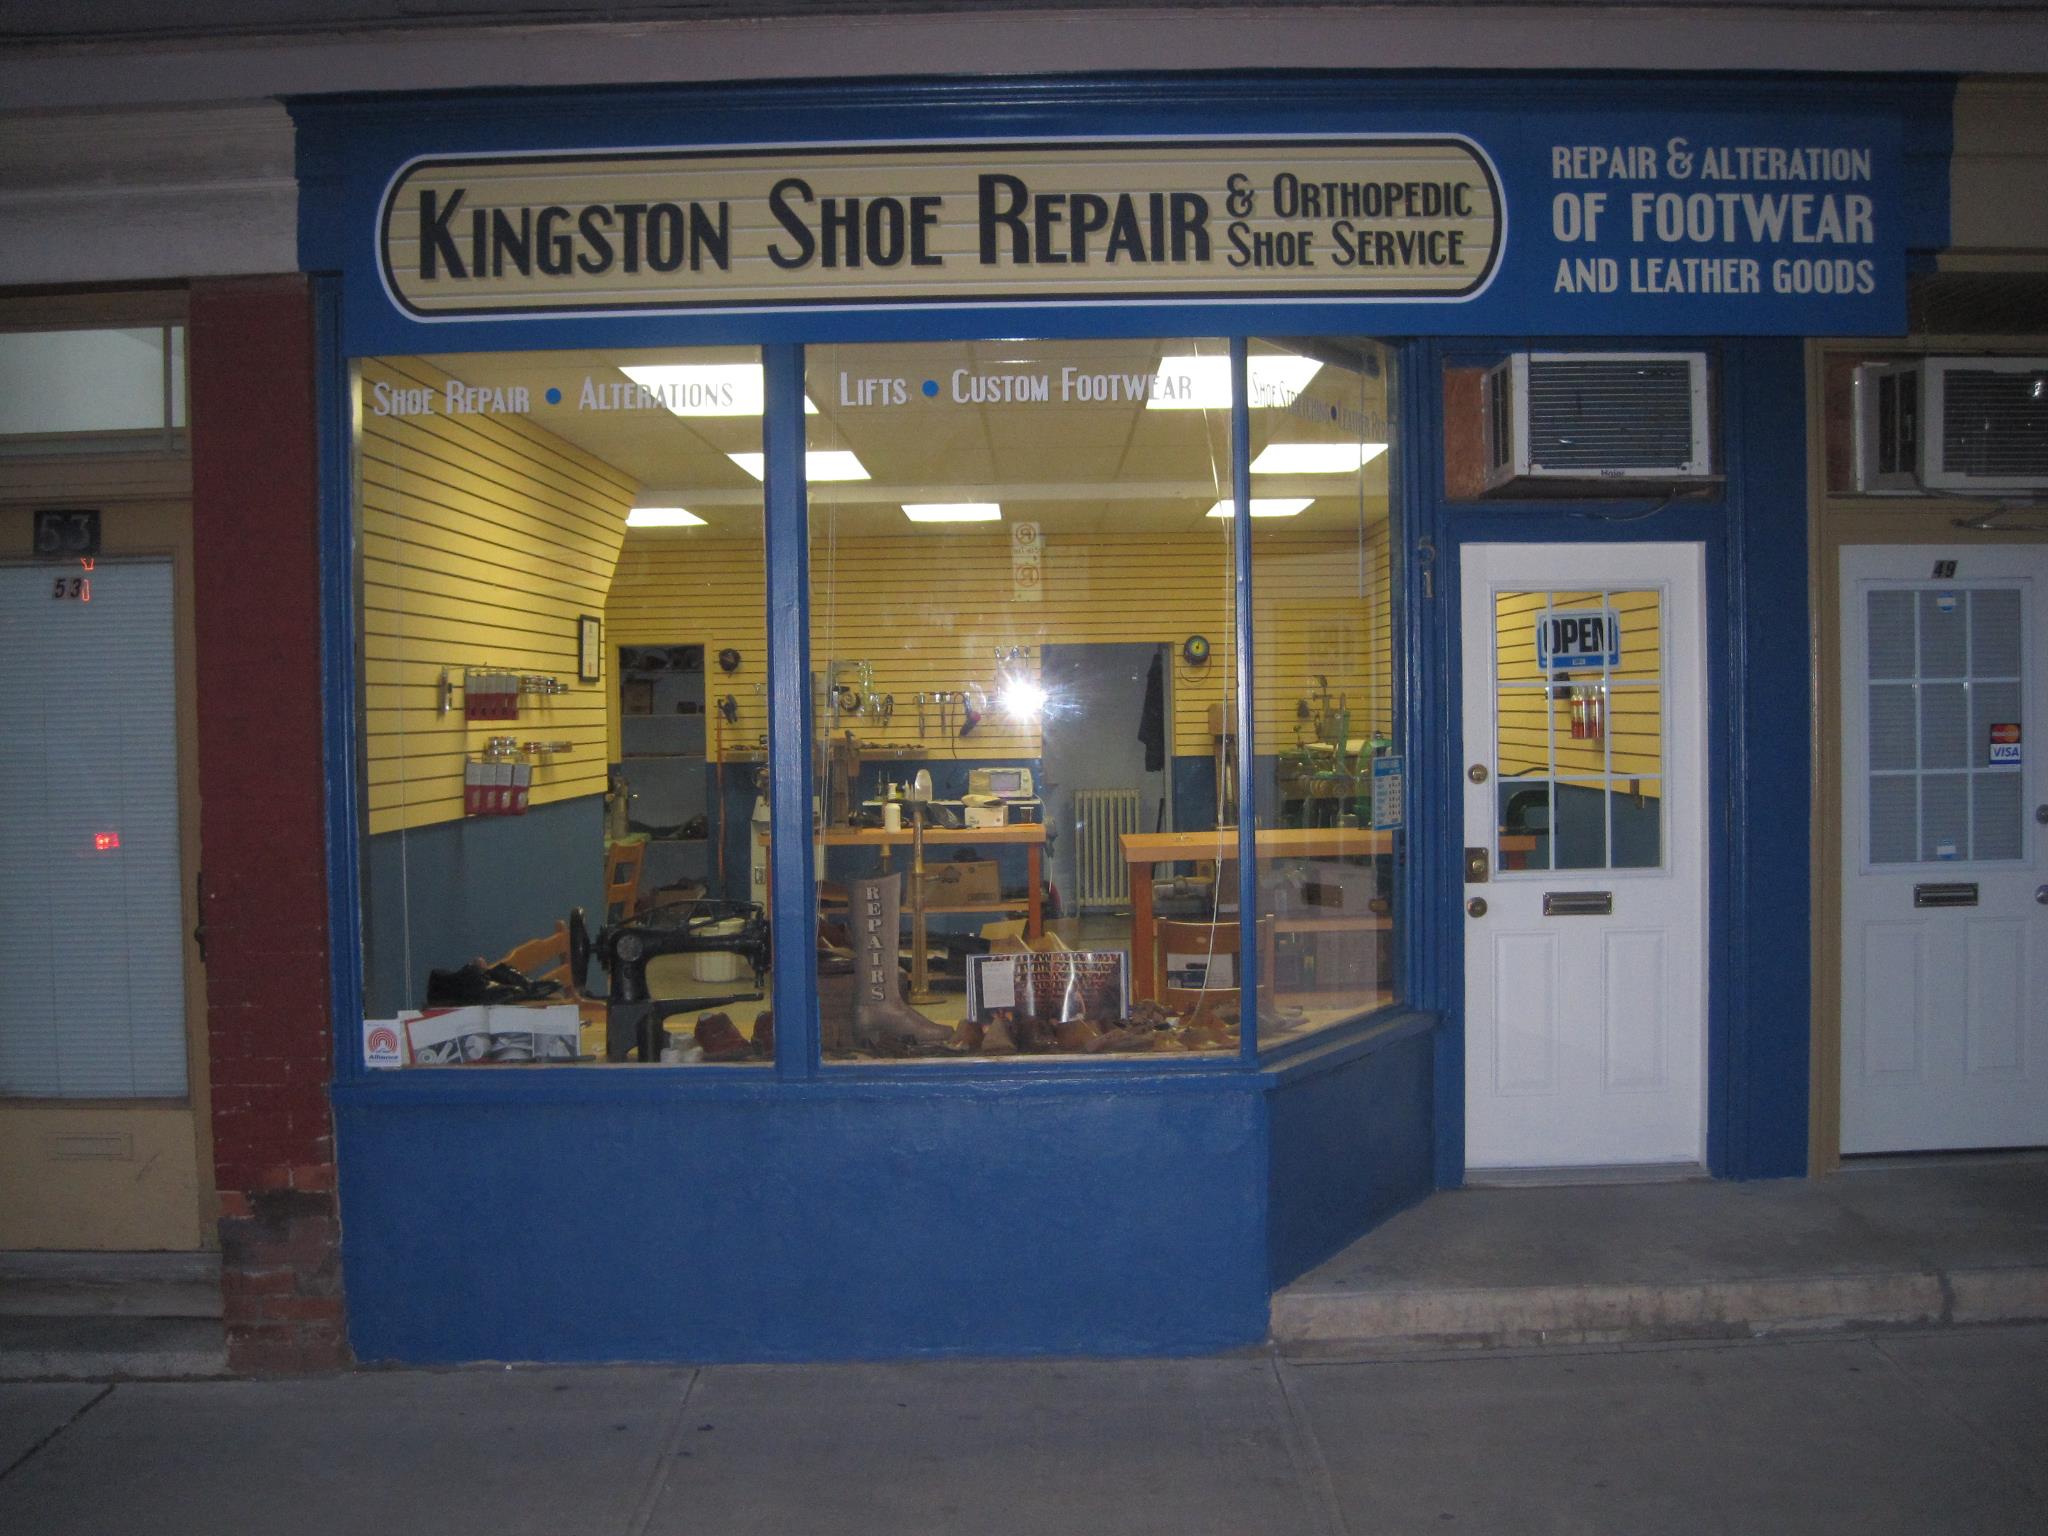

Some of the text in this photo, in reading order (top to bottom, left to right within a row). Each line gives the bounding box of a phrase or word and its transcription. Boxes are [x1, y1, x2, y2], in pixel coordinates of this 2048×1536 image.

[1552, 137, 1871, 182] REPAIR & ALTERATION
[1226, 172, 1473, 219] & ORTHOPEDIC
[419, 173, 1211, 280] KINGSTON SHOE REPAIR
[1553, 192, 1874, 244] OF FOOTWEAR
[1227, 220, 1465, 268] SHOE SERVICE
[1554, 258, 1875, 295] AND LEATHER GOODS
[372, 376, 734, 416] SHOE REPAIR ALTERATIONS
[840, 367, 1192, 407] LIFTS CUSTOM FOOTWEAR
[1251, 371, 1277, 409] SHOE
[40, 513, 89, 551] 53
[55, 577, 81, 598] 53
[1542, 616, 1613, 654] OPEN
[1993, 746, 2020, 758] VISA
[865, 887, 885, 1001] REPAIRS
